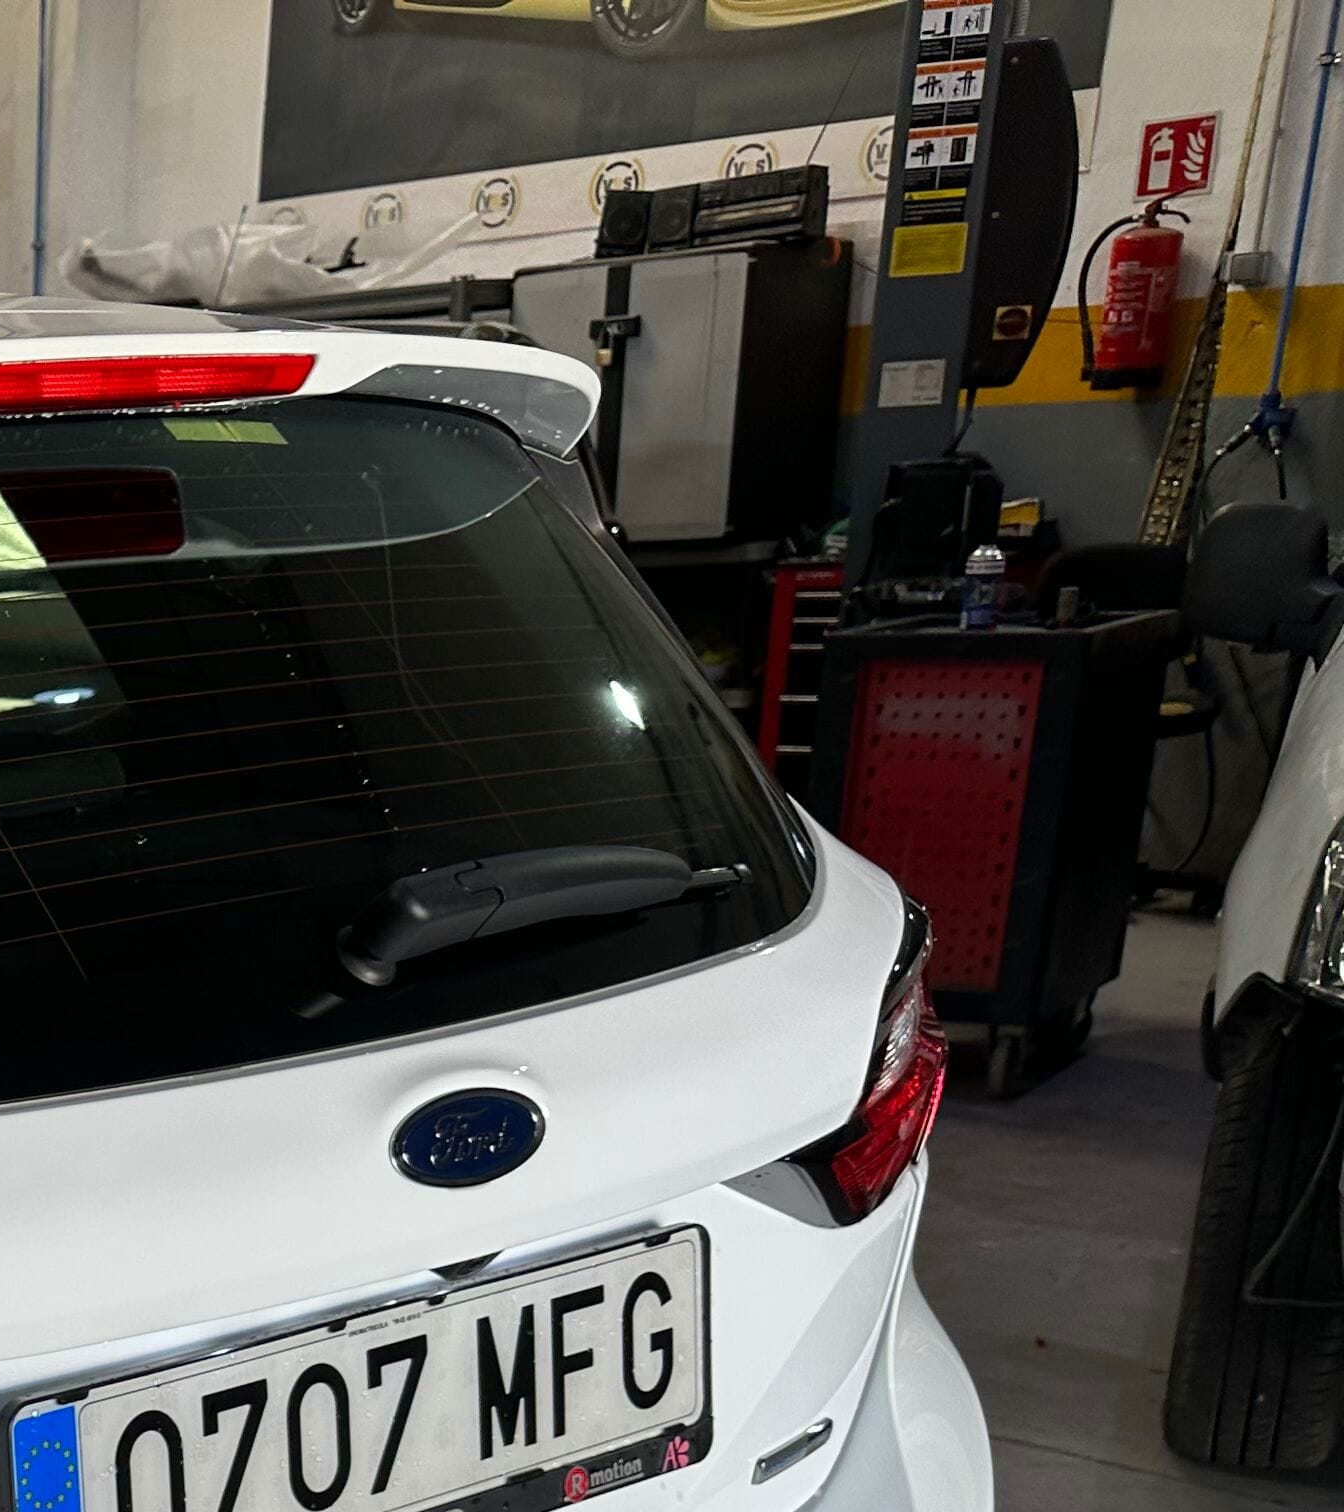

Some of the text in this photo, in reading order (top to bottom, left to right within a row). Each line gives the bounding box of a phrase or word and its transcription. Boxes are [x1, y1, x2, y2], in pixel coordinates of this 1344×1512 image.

[430, 1107, 514, 1168] Ford
[476, 1271, 674, 1461] MFG
[590, 1458, 643, 1487] motion
